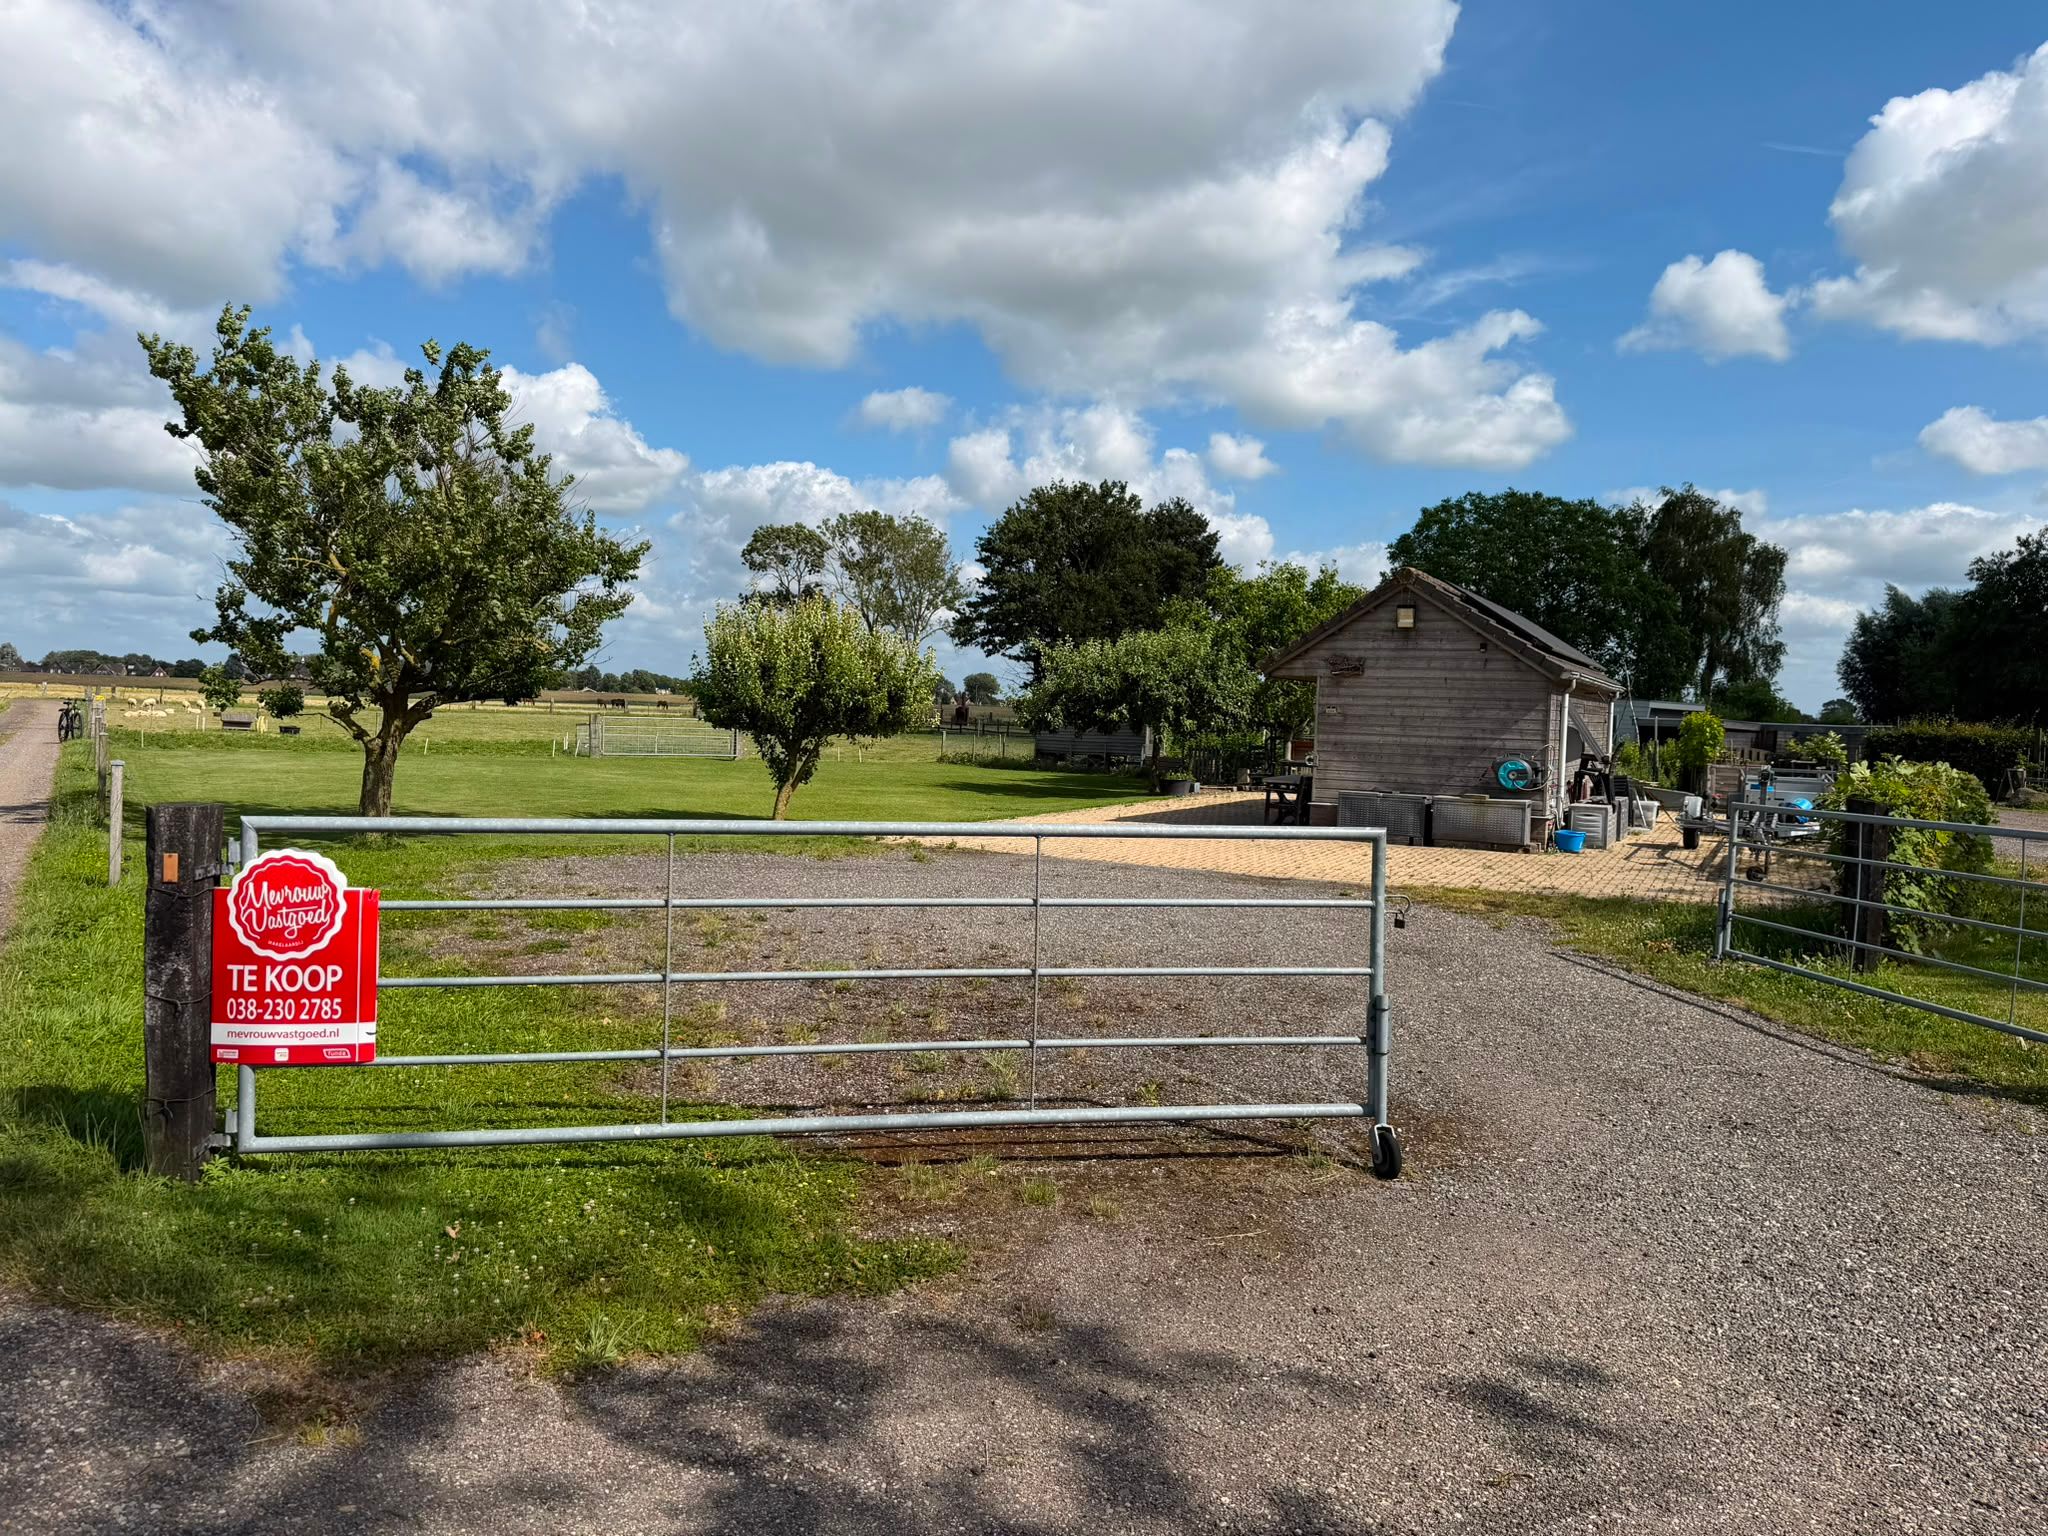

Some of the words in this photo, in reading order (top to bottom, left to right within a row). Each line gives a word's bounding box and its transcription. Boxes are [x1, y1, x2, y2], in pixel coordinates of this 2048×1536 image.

[242, 881, 329, 910] Mevrouw
[243, 899, 329, 939] Vastgoed
[226, 964, 258, 992] TE
[265, 964, 343, 993] KOOP
[226, 997, 296, 1020] 038-230
[299, 998, 342, 1020] 2785
[227, 1027, 340, 1041] mevrouwvastgoed.nl
